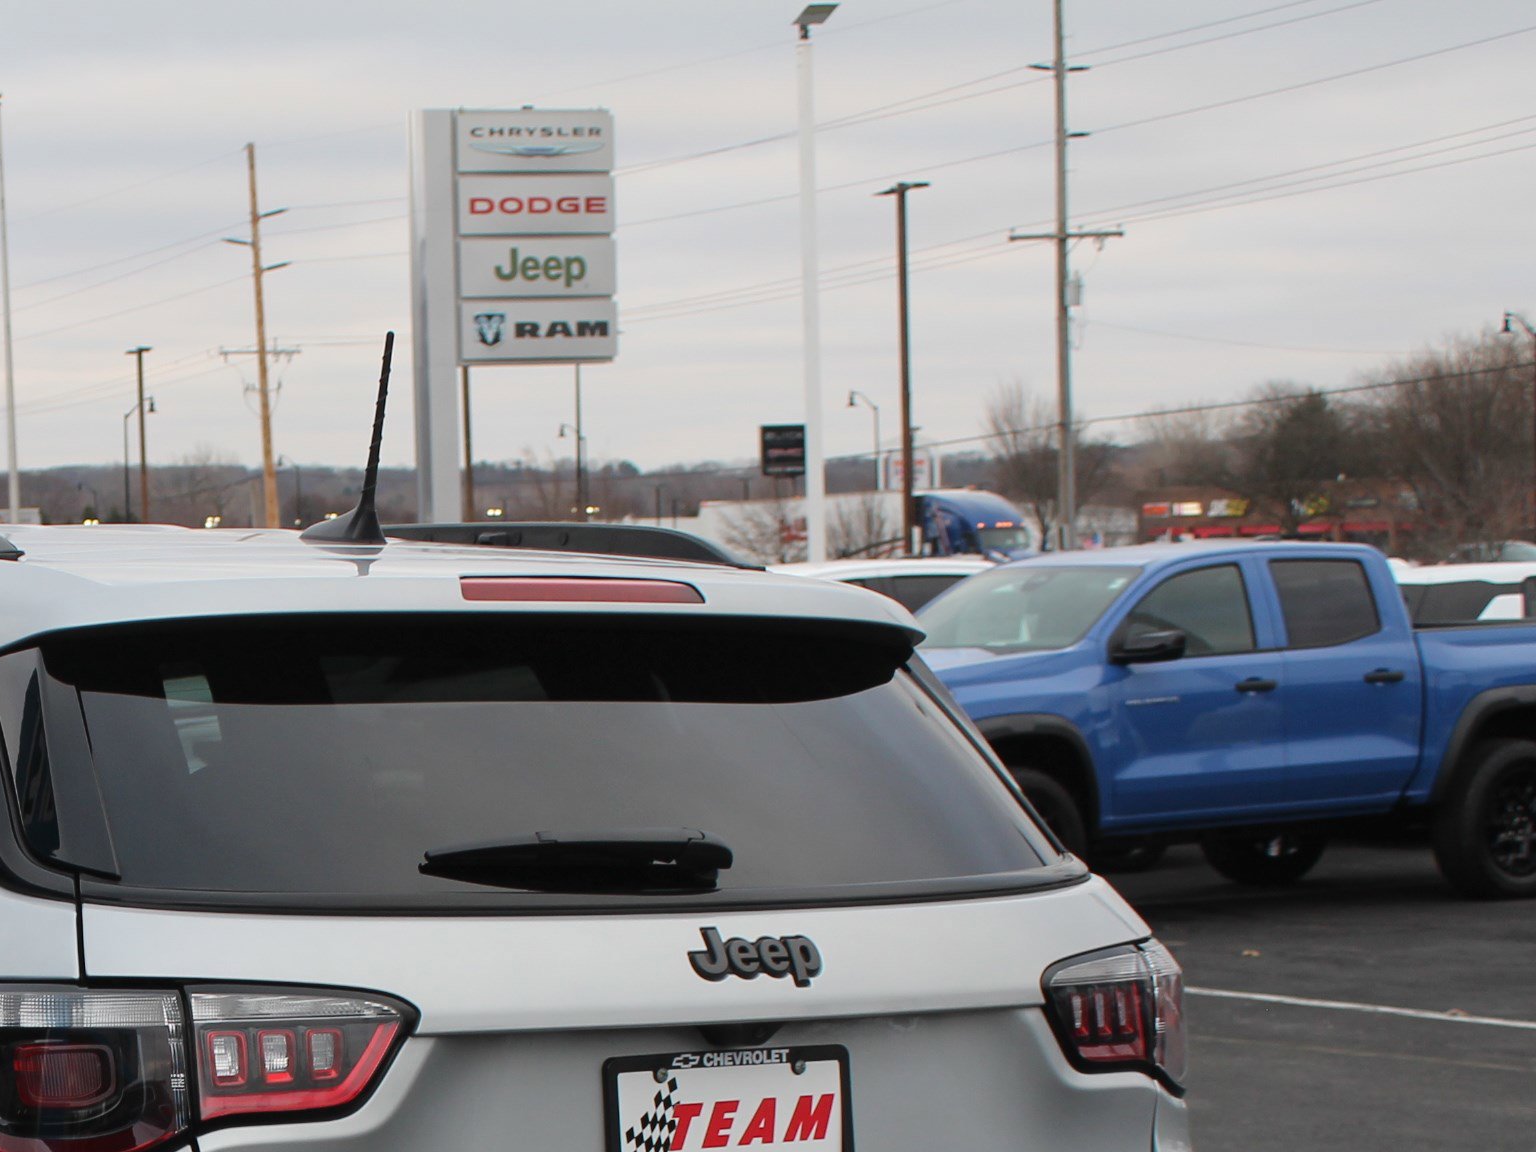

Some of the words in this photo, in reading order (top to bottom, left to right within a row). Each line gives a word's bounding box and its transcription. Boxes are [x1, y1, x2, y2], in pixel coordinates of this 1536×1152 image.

[469, 126, 602, 138] CHRYSLER
[469, 197, 607, 215] DODGE
[494, 247, 587, 288] Jeep
[514, 320, 609, 339] RAM
[687, 926, 823, 988] Jeep
[703, 1049, 790, 1067] CHEVROLET
[669, 1093, 835, 1151] TEAM
